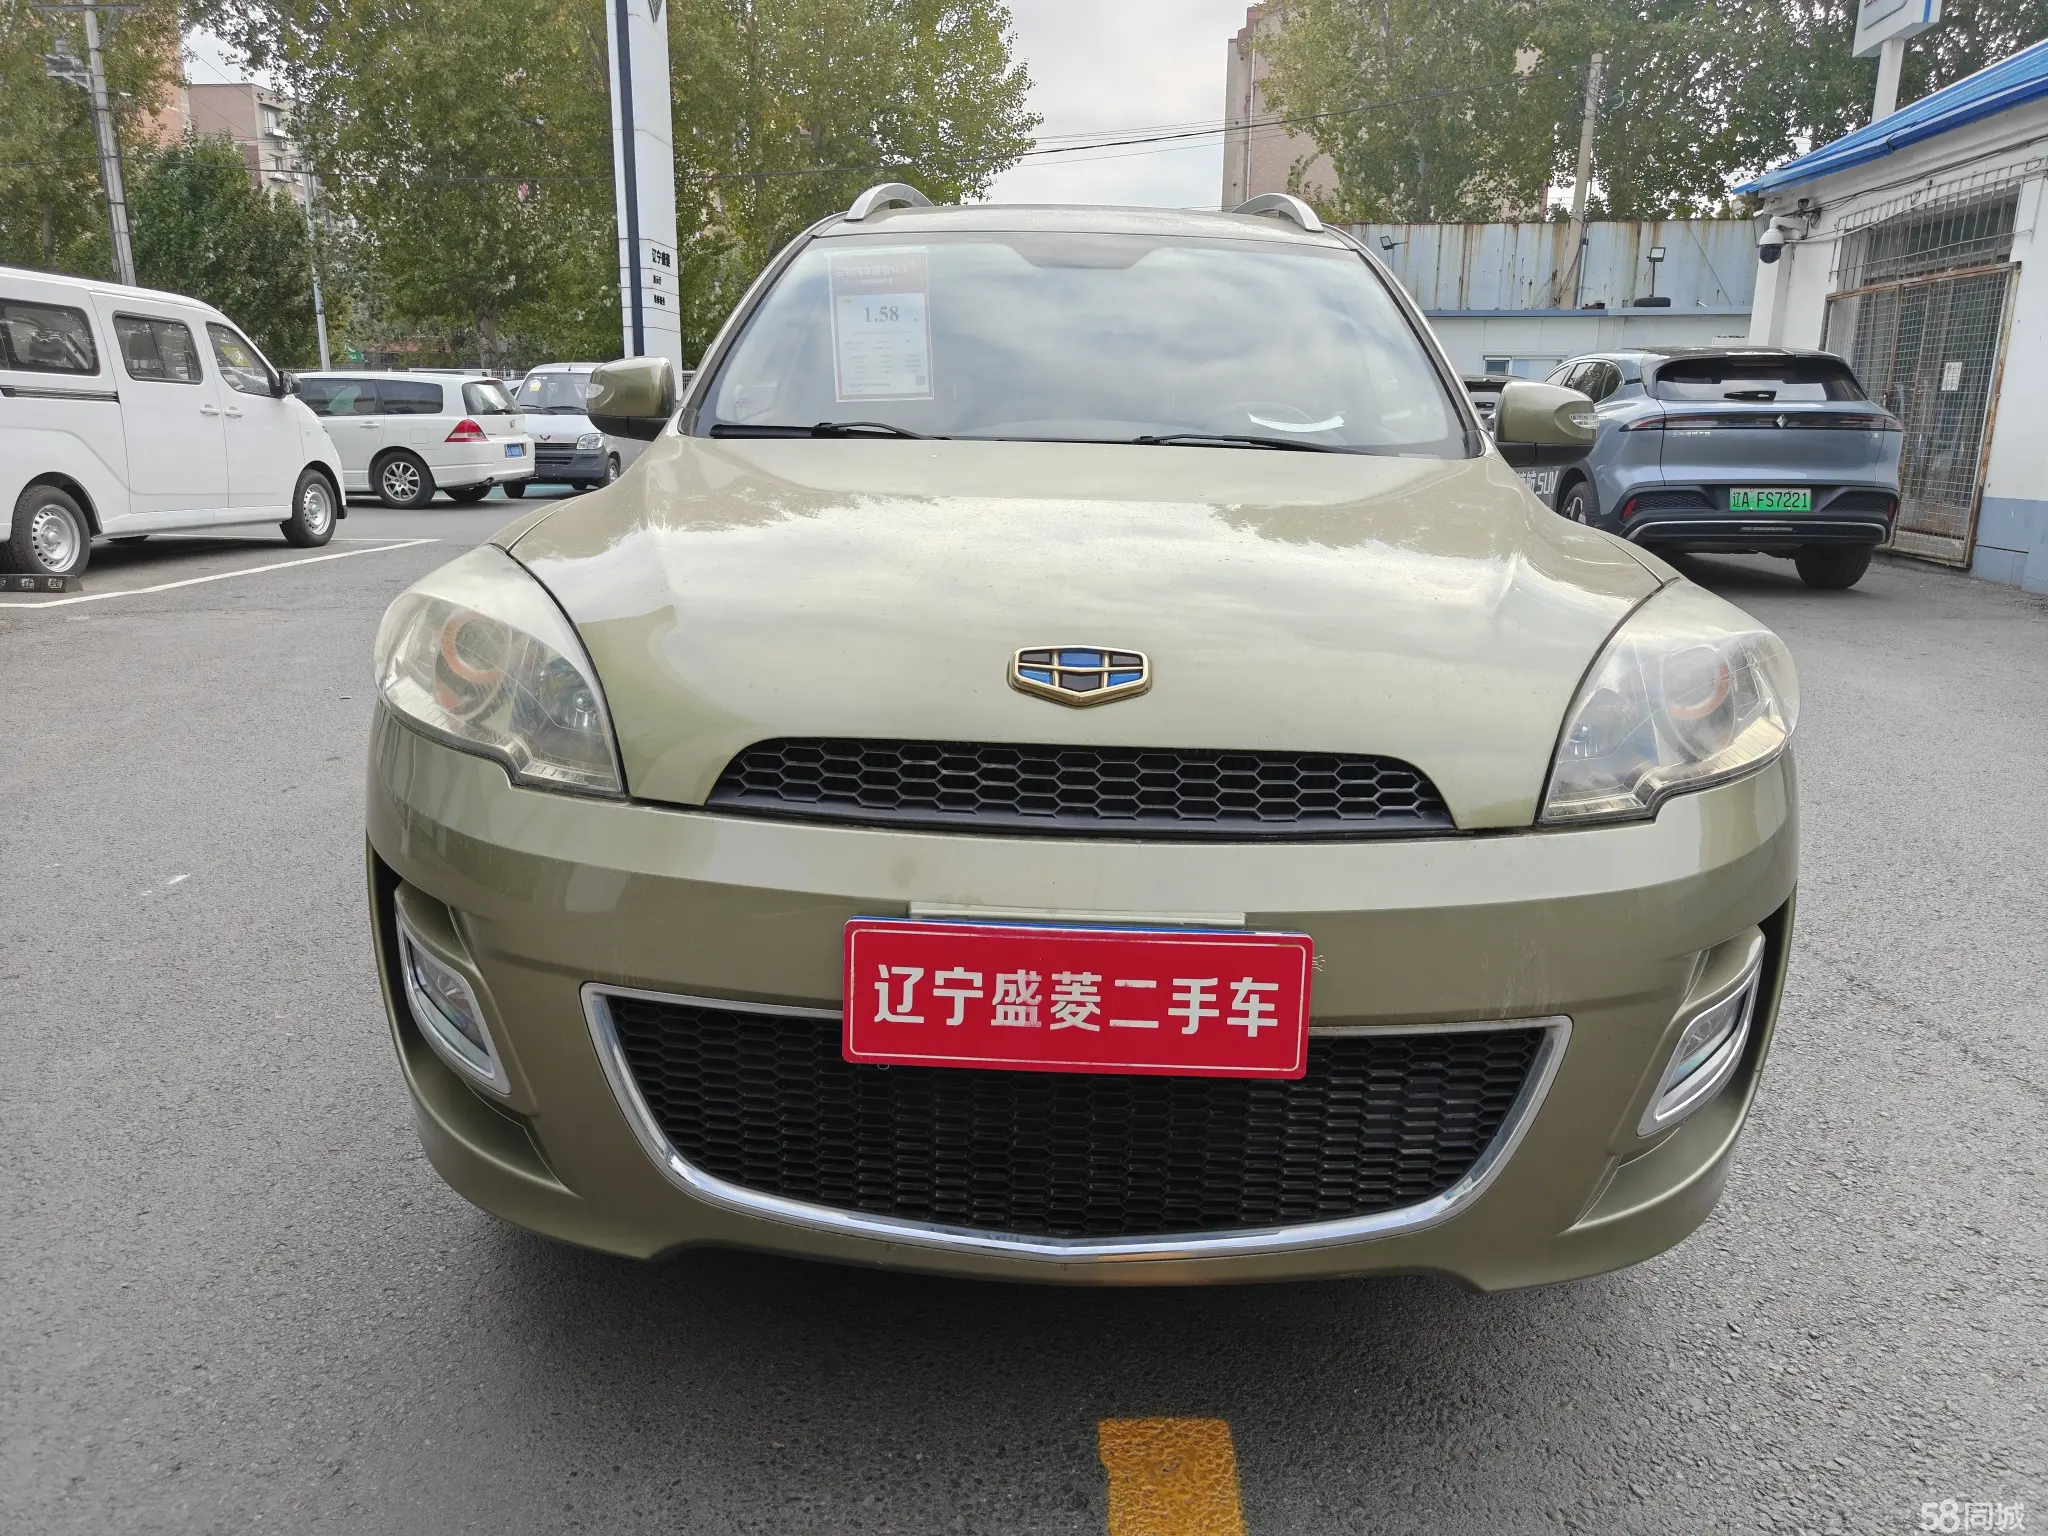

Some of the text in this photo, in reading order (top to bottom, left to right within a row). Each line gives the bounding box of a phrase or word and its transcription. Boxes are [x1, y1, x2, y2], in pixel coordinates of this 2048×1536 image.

[864, 305, 899, 323] 1.58
[1536, 470, 1559, 495] SUV
[1756, 491, 1808, 508] FS7221
[873, 963, 1280, 1038] 辽宁盛菱二手车
